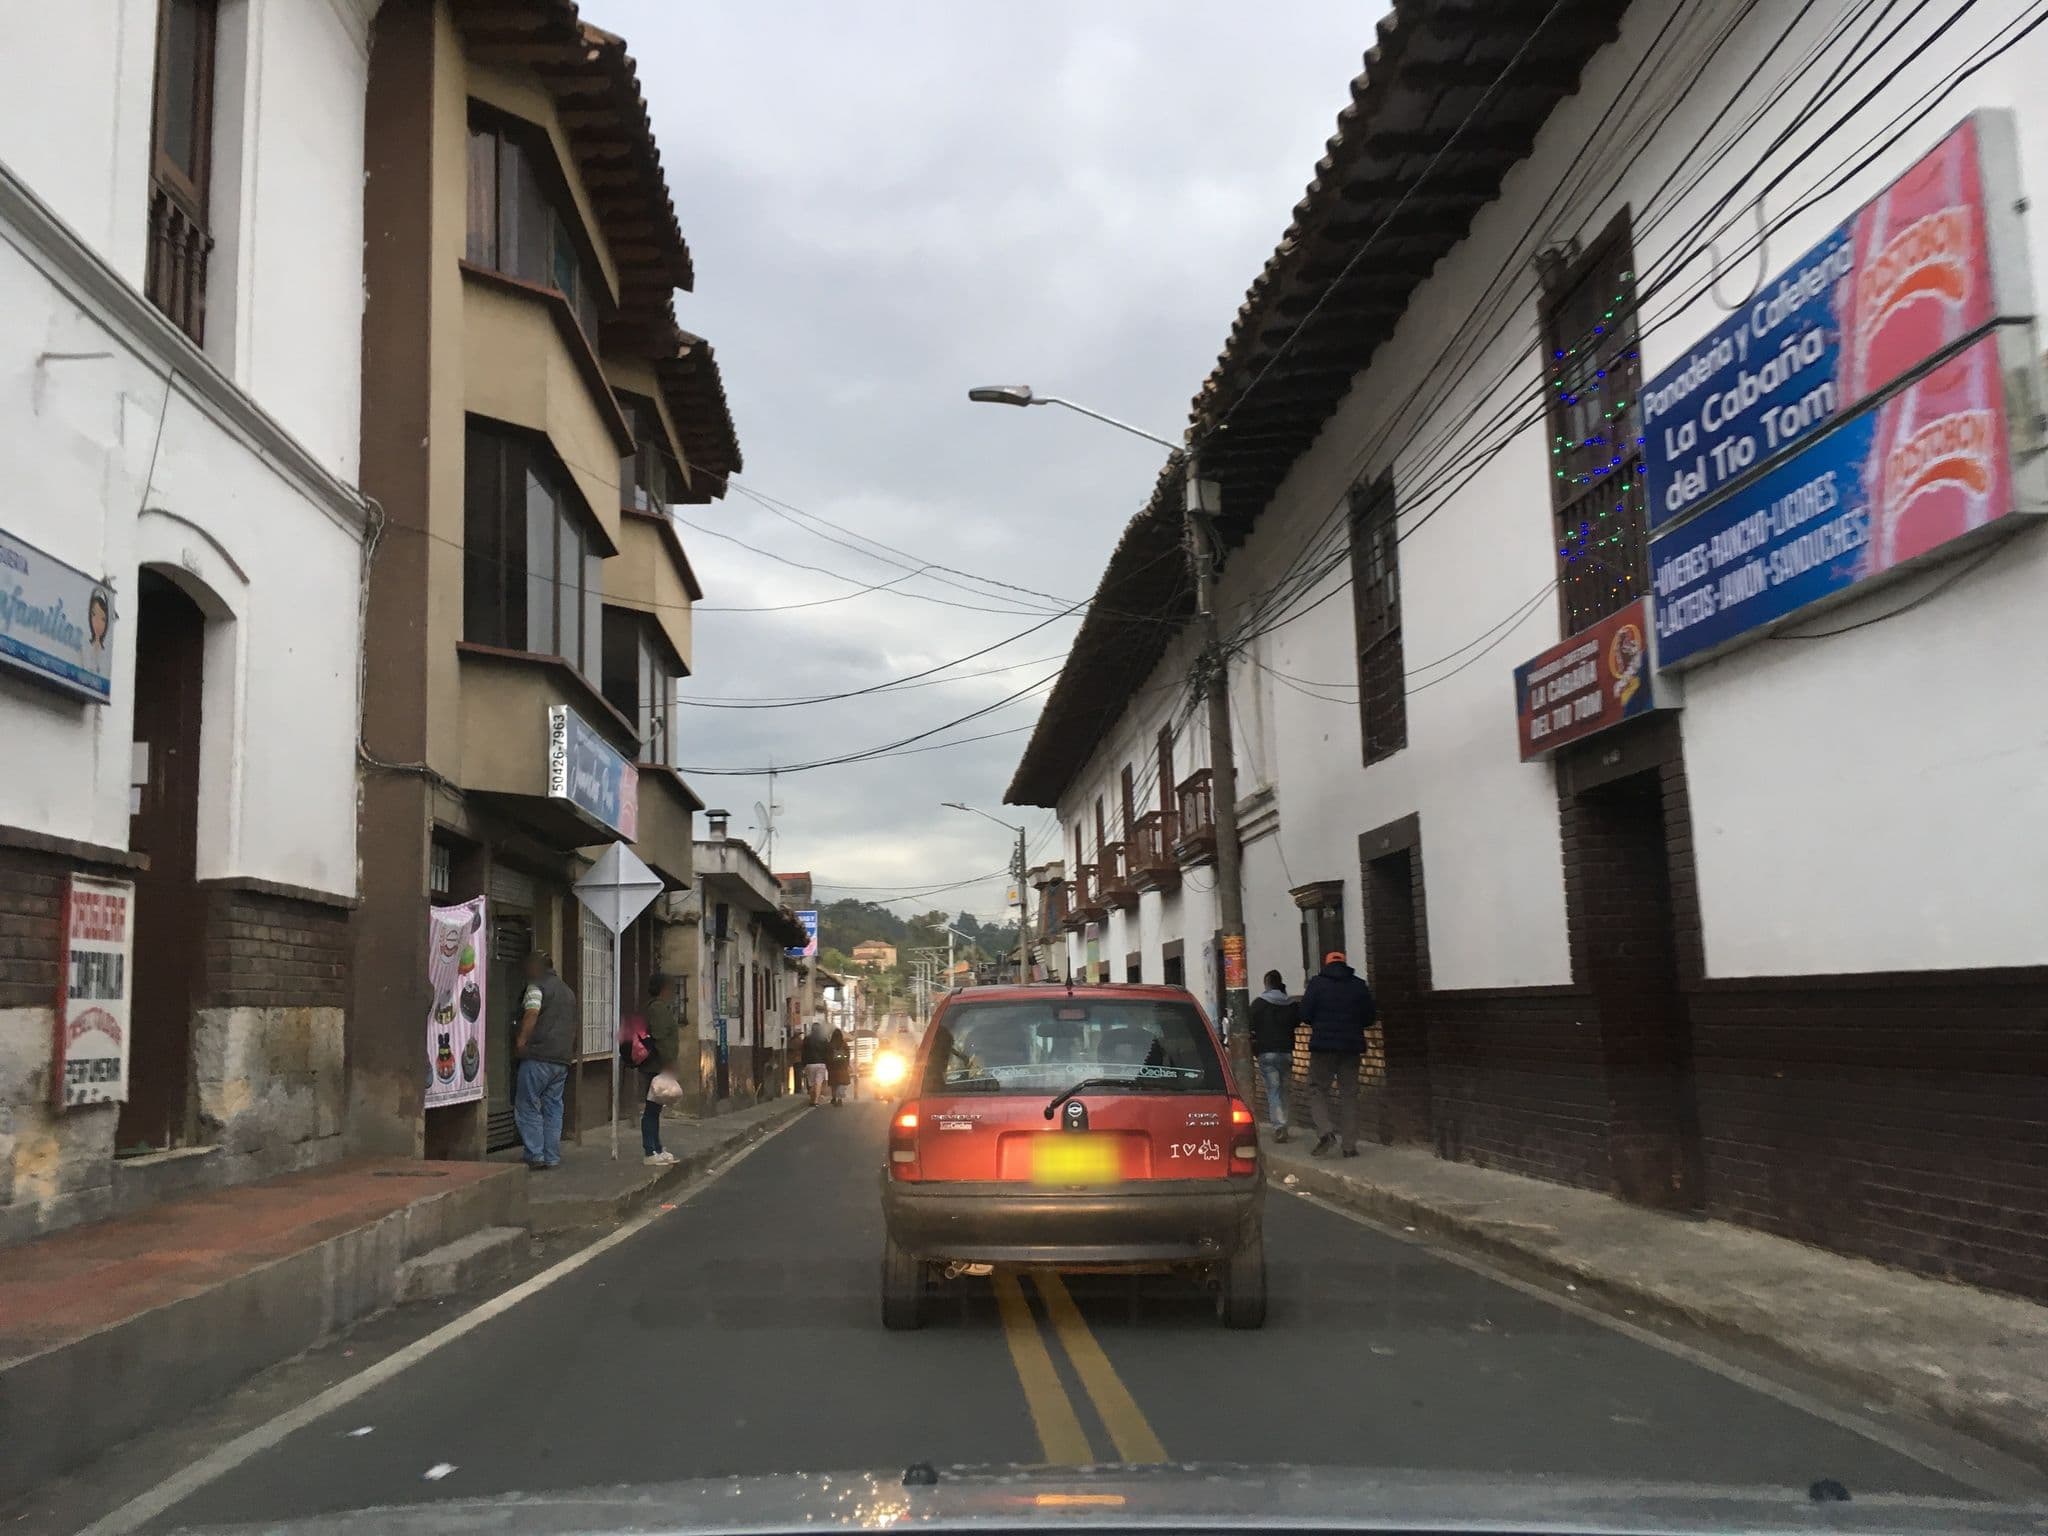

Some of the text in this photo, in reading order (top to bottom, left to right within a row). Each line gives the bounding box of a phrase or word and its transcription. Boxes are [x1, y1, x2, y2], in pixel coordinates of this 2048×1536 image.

[1734, 322, 1749, 362] y
[1665, 326, 1825, 462] La Cabaña
[1666, 459, 1708, 511] del
[1760, 380, 1837, 449] Tom
[551, 714, 566, 792] 50426-7963
[1140, 1065, 1177, 1078] Coches
